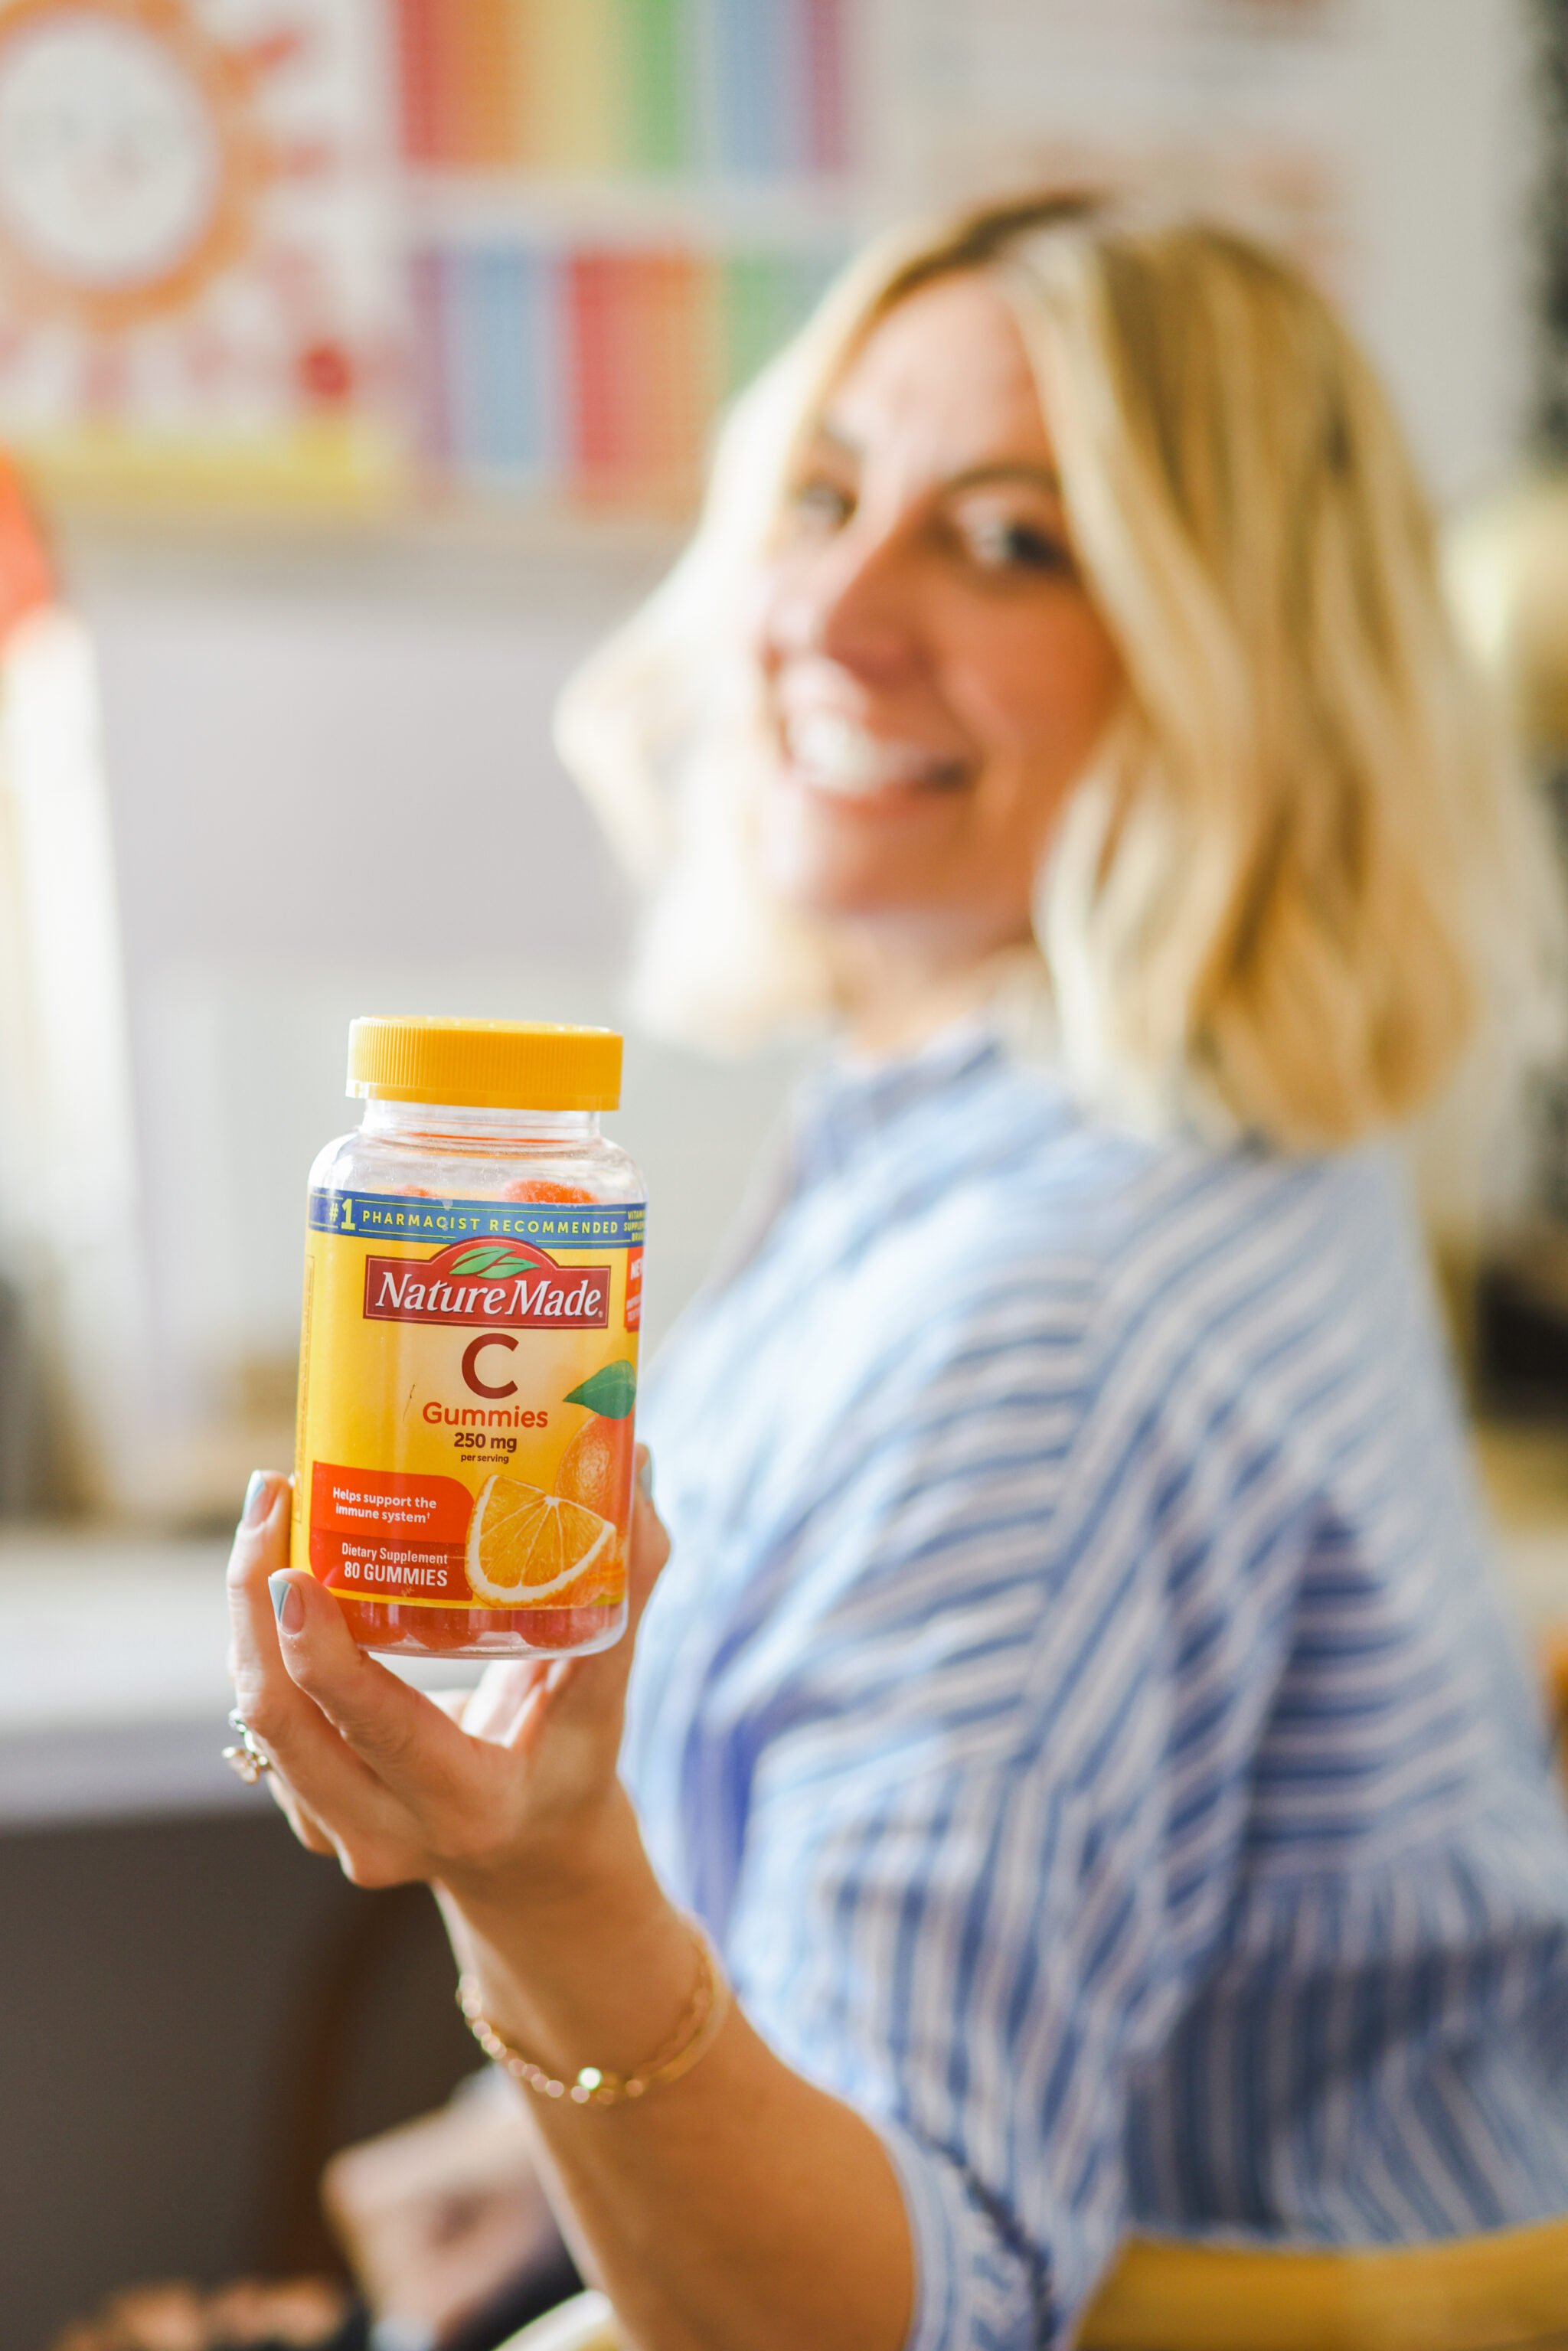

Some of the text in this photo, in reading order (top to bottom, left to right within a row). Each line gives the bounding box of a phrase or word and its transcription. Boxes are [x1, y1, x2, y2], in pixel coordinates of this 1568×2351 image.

[328, 1198, 619, 1234] #1 PHARMACIST RECOMMENDED
[375, 1272, 506, 1314] Nature
[461, 1332, 519, 1399] C
[423, 1401, 549, 1429] Gummies
[453, 1432, 518, 1453] 250 mg
[460, 1454, 509, 1464] per serving
[332, 1487, 437, 1509] Helps support the
[335, 1502, 379, 1520] immune
[341, 1542, 448, 1565] Dietary Supplement
[344, 1561, 448, 1587] 80 GUMMIES
